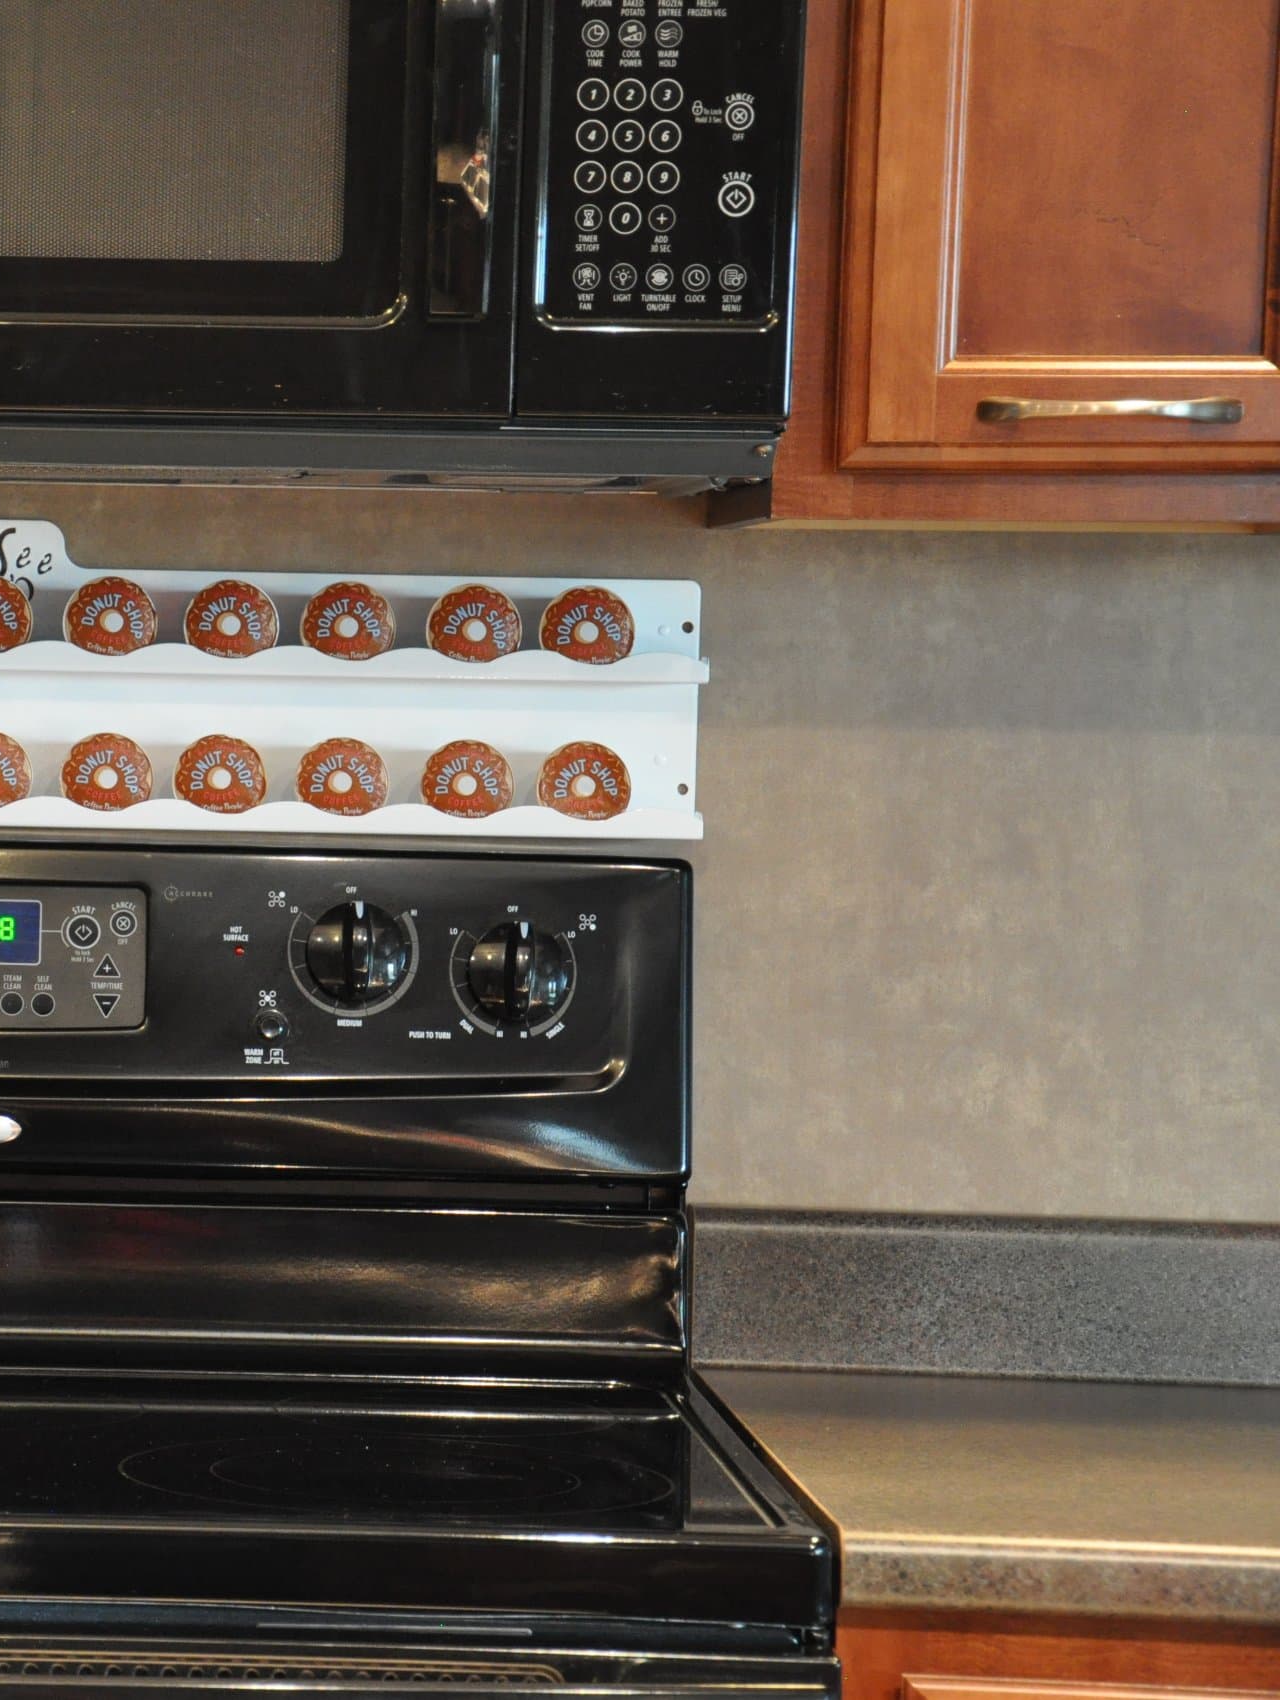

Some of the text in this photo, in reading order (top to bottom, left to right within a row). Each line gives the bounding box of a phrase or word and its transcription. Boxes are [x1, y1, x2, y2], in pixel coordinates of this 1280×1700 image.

[586, 50, 604, 58] COOK
[622, 50, 640, 58] COOK
[657, 50, 679, 58] WARM
[587, 59, 602, 67] TIME
[619, 59, 642, 67] POWER
[659, 60, 676, 68] HOLD
[590, 89, 597, 100] 1
[625, 89, 635, 101] 2
[663, 89, 671, 101] 3
[587, 131, 597, 141] 4
[624, 131, 634, 142] 5
[661, 131, 670, 142] 6
[587, 171, 596, 182] 7
[623, 171, 631, 183] 8
[660, 171, 669, 183] 9
[722, 171, 753, 183] START
[621, 213, 630, 224] 0
[578, 235, 598, 243] TIMER
[654, 235, 669, 243] ADD
[577, 293, 594, 302] VENT
[612, 293, 632, 302] LIGHT
[684, 294, 706, 303] CLOCK
[722, 295, 743, 303] SETUP
[579, 302, 592, 311] FAN
[646, 303, 670, 311] ON/OFF
[721, 304, 742, 312] MENU
[81, 593, 144, 639] DONUT SHOP
[198, 596, 261, 640] DONUT SHOP
[317, 599, 381, 638] DONUT SHOP
[443, 603, 507, 649] DONUT SHOP
[556, 605, 621, 645] DONUT SHOP
[75, 750, 138, 794] DONUT SHOP
[190, 750, 253, 790] DONUT SHOP
[310, 754, 374, 793] DONUT SHOP
[435, 756, 498, 796] DONUT SHOP
[553, 759, 618, 799] DONUT SHOP
[71, 905, 96, 915] START
